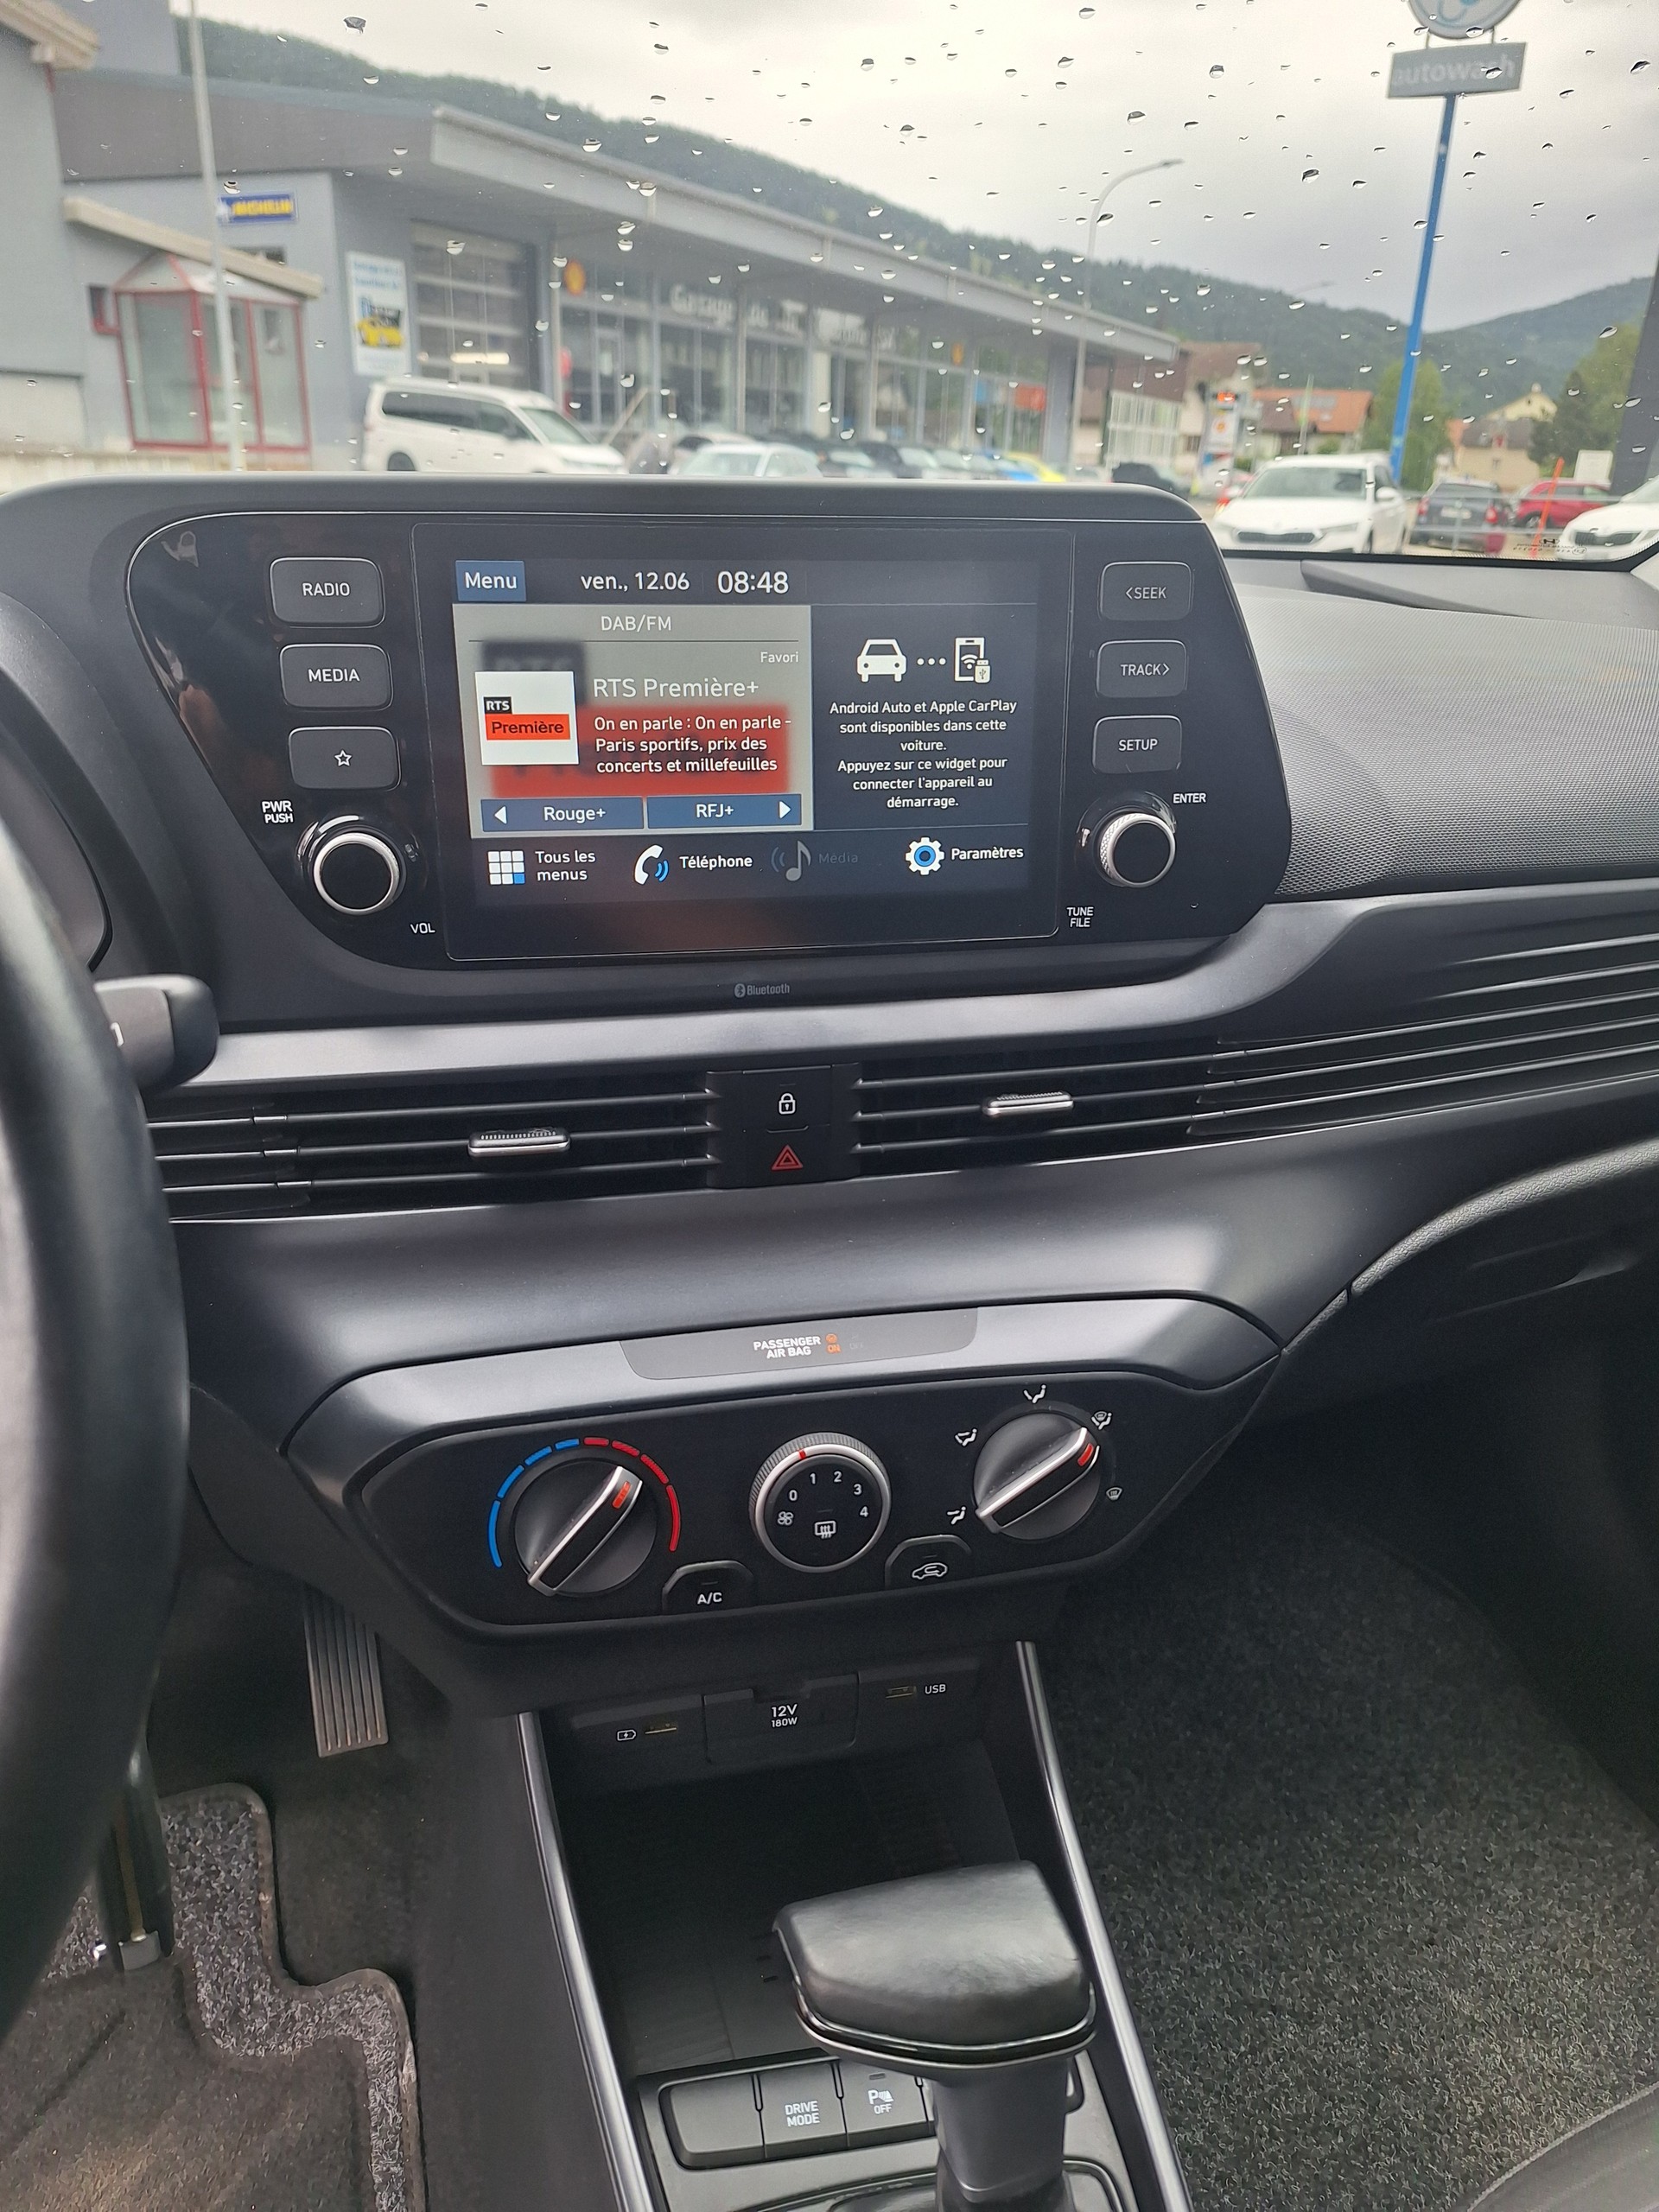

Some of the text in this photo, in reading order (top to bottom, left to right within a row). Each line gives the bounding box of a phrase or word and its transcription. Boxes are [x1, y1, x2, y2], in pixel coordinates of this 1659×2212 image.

[466, 572, 516, 588] Menu
[582, 572, 689, 591] ven., 12.06
[718, 571, 788, 593] 08:48
[302, 583, 349, 595] RADIO
[601, 615, 671, 632] DAB/FM
[761, 652, 798, 662] Favori
[308, 669, 359, 682] MEDIA
[594, 677, 758, 697] RTS Première+
[486, 699, 511, 712] RTS
[830, 700, 1016, 715] Android Auto et Apple CarPlay
[492, 721, 564, 734] Première
[595, 717, 614, 730] On
[620, 721, 637, 729] en
[643, 716, 683, 733] parle
[696, 716, 715, 729] On
[721, 719, 737, 728] en
[742, 715, 780, 732] parle
[841, 720, 1006, 734] sont disponibles dans cette
[596, 737, 766, 754] Paris sportifs, prix des
[901, 740, 946, 750] voiture.
[1119, 739, 1157, 751] SETUP
[597, 758, 777, 772] concerts et millefeuilles
[838, 760, 890, 773] Appuyez
[936, 758, 976, 771] widget
[980, 760, 1007, 770] pour
[854, 779, 914, 790] connecter
[918, 776, 975, 790] l'appareil
[887, 797, 958, 808] démarrage.
[1173, 793, 1205, 803] ENTER
[262, 801, 292, 812] PWR
[696, 804, 734, 817] RFJ+
[265, 813, 293, 823] PUSH
[544, 807, 605, 823] Rouge+
[535, 850, 595, 863] Tous les
[952, 847, 1023, 860] Paramètres
[680, 855, 752, 870] Téléphone
[537, 869, 588, 881] menus
[1067, 907, 1093, 916] TUNE
[410, 923, 435, 933] VOL
[1071, 918, 1090, 927] FILE
[747, 983, 790, 995] Bluetooth
[753, 1336, 821, 1351] PASSENGER
[767, 1346, 811, 1358] AIR BAG
[810, 1473, 815, 1484] 1
[835, 1471, 841, 1482] 2
[855, 1484, 861, 1494] 3
[790, 1491, 797, 1501] 0
[861, 1507, 868, 1516] 4
[698, 1592, 721, 1604] A/C
[925, 1684, 945, 1694] USB
[771, 1704, 798, 1717] 12V
[772, 1717, 797, 1727] 180W
[785, 2100, 819, 2114] DRIVE
[874, 2104, 891, 2113] OFF
[787, 2113, 821, 2127] MODE
